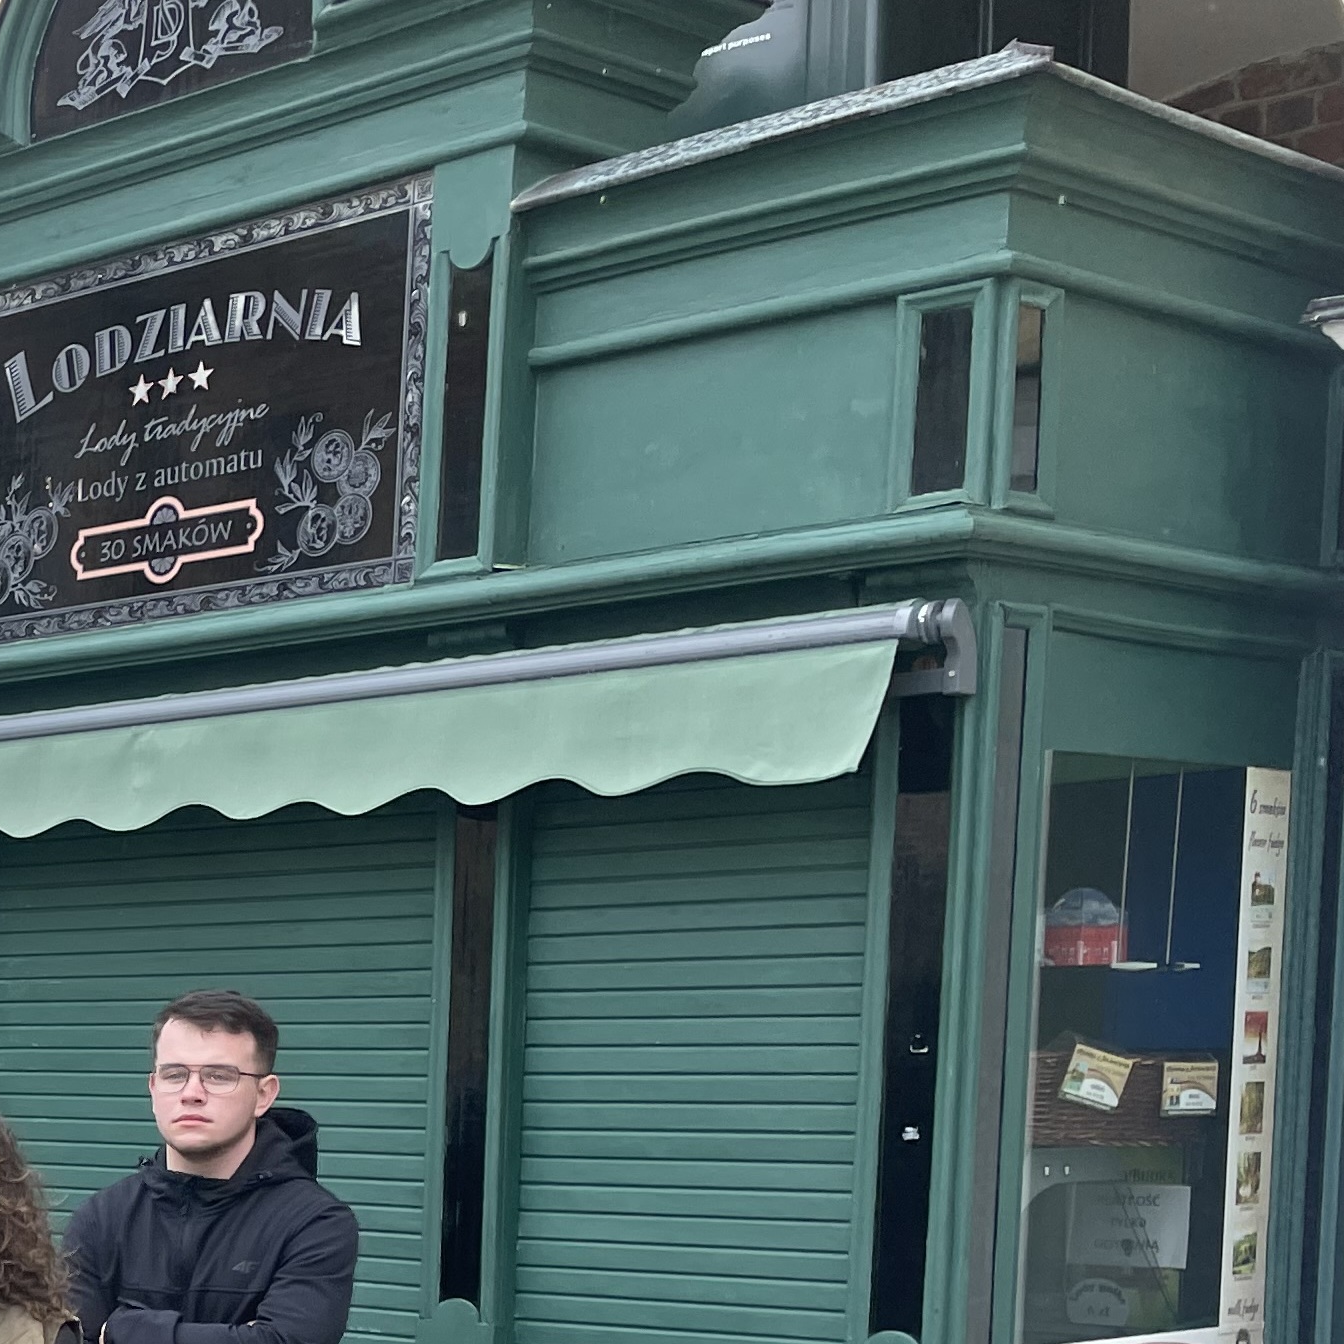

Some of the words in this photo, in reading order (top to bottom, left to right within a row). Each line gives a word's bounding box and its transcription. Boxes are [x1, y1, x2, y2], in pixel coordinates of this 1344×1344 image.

[4, 288, 362, 424] LODZIARNIA
[74, 419, 139, 467] Lody
[143, 398, 270, 453] tradycyjne
[77, 470, 129, 502] Lody
[135, 472, 147, 492] z
[153, 448, 264, 488] automatu
[99, 535, 126, 563] 30
[131, 518, 234, 557] SMAKÓW
